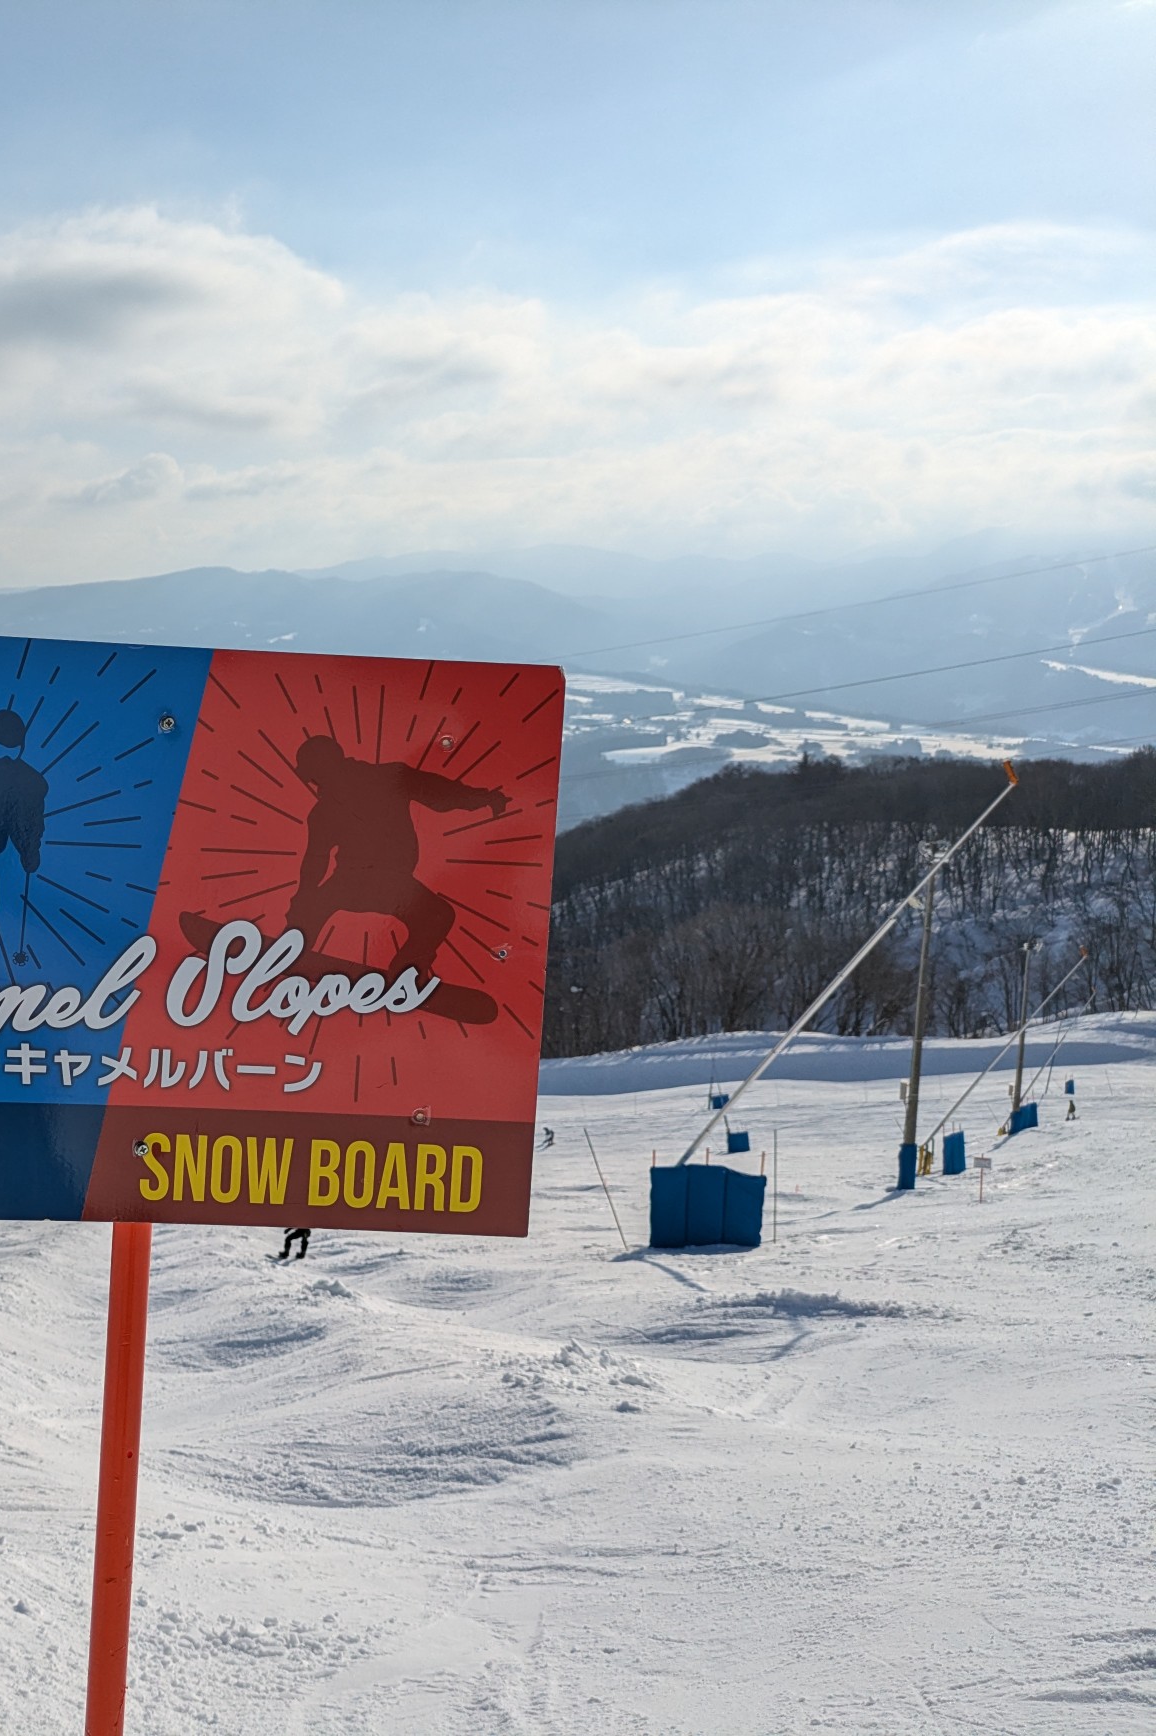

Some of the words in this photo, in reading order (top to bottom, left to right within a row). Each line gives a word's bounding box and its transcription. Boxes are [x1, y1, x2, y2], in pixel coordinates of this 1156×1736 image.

[166, 920, 441, 1035] Slopes
[4, 1043, 322, 1093] キャメルバーン
[139, 1132, 294, 1205] SNOW
[307, 1139, 483, 1213] BOARD
